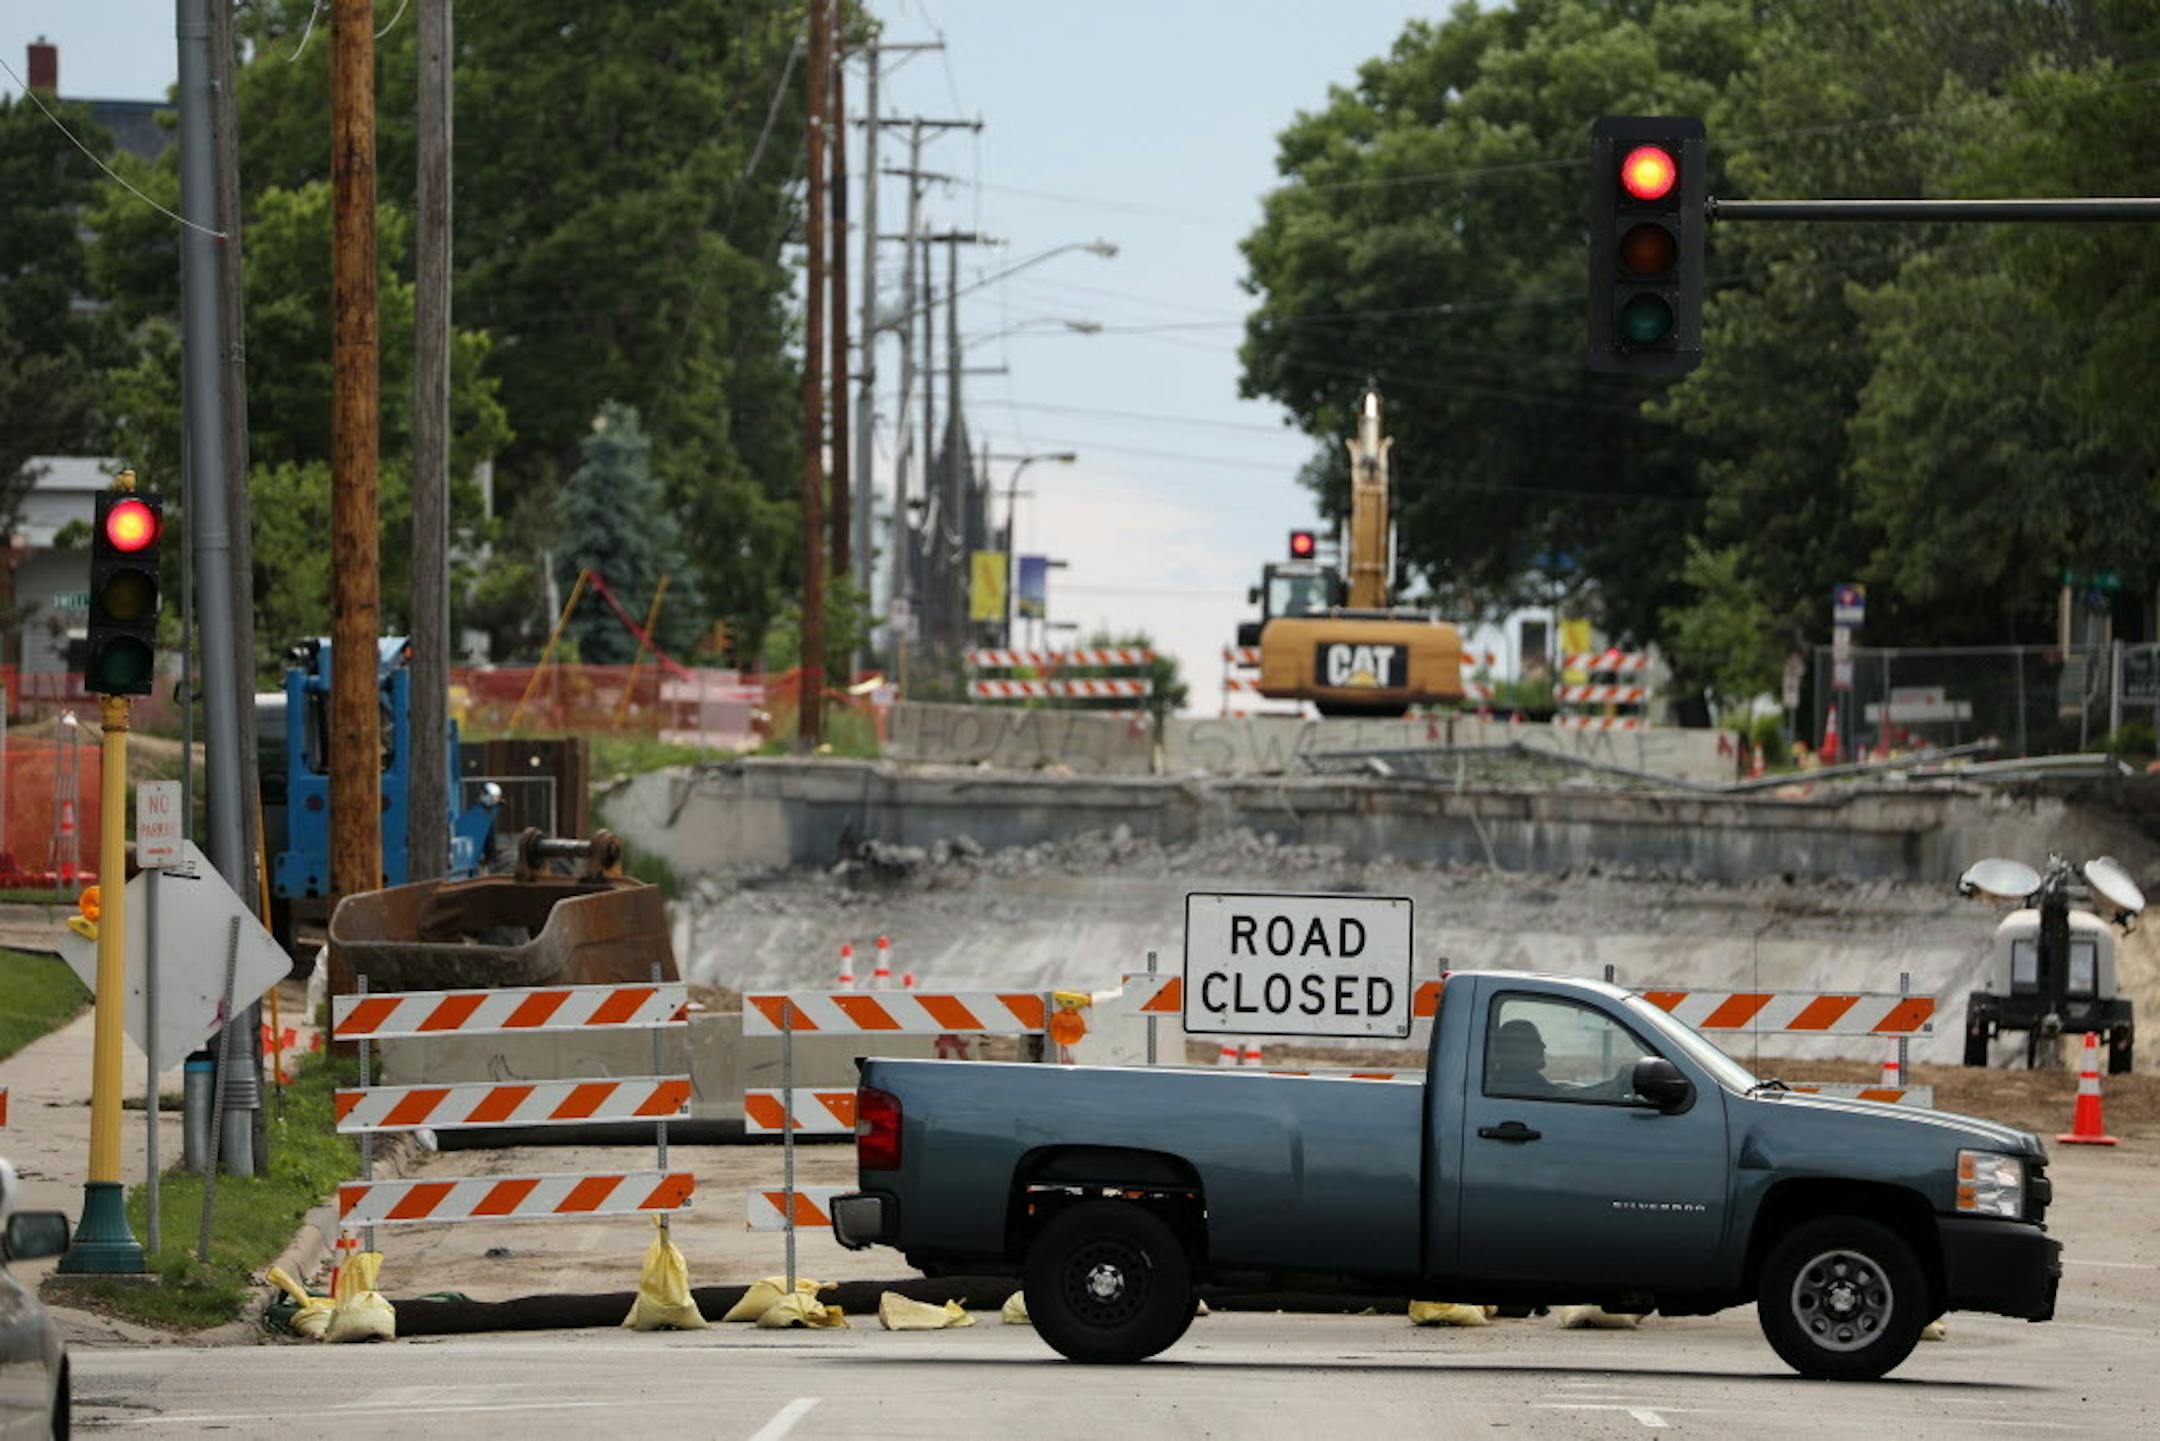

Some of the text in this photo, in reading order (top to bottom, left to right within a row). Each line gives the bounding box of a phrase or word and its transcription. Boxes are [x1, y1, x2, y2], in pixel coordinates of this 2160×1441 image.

[1327, 643, 1395, 688] CAT
[916, 706, 1102, 758] HOME
[148, 794, 170, 815] NO
[1231, 915, 1366, 958] ROAD
[1202, 972, 1394, 1016] CLOSED
